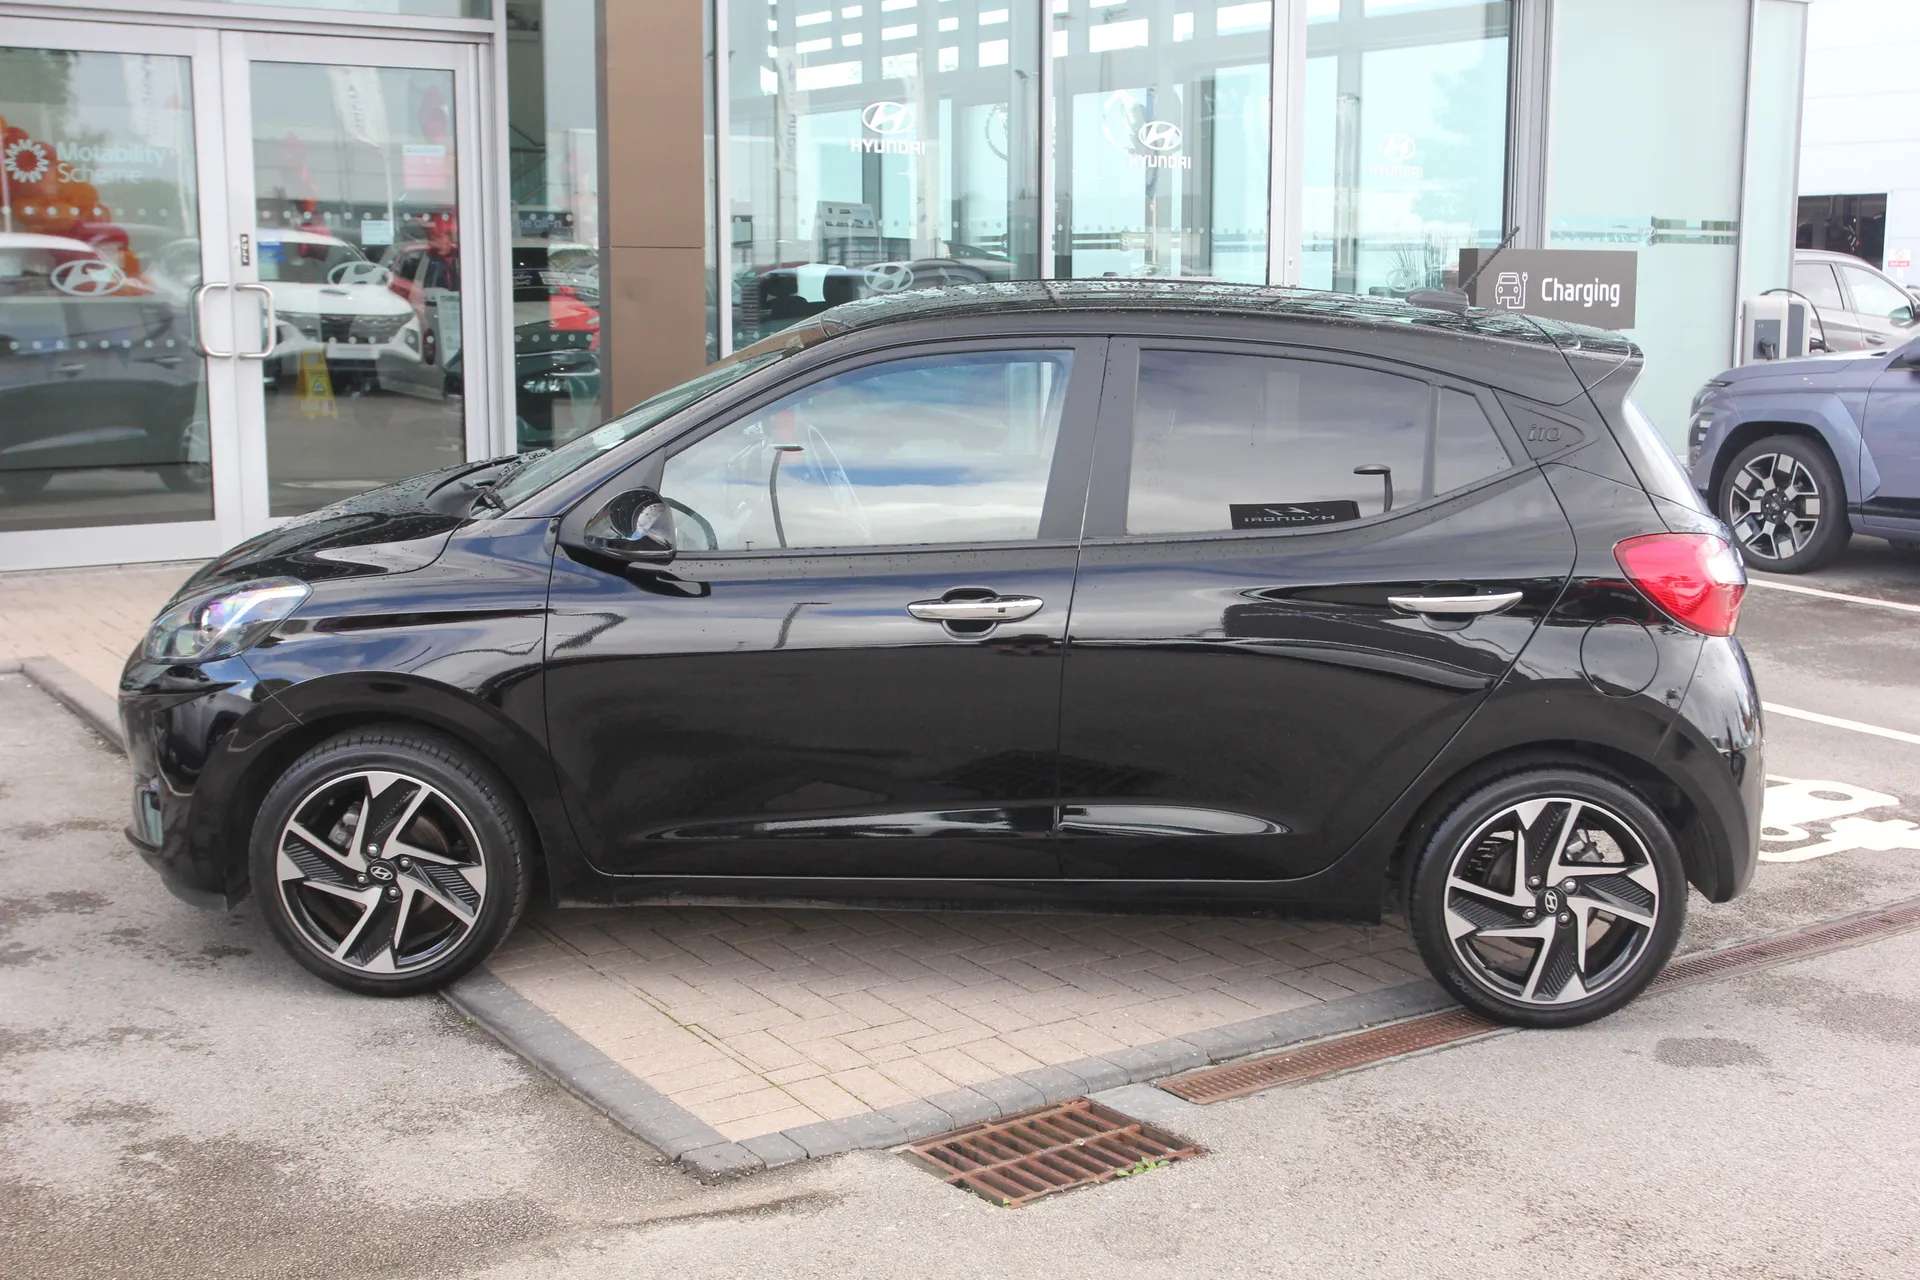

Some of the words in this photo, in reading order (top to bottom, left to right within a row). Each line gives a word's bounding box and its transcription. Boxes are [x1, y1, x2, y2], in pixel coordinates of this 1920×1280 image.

[56, 141, 167, 168] Motability
[850, 138, 926, 155] HYUNDAI
[57, 162, 144, 184] Scheme
[1541, 277, 1620, 307] Charging
